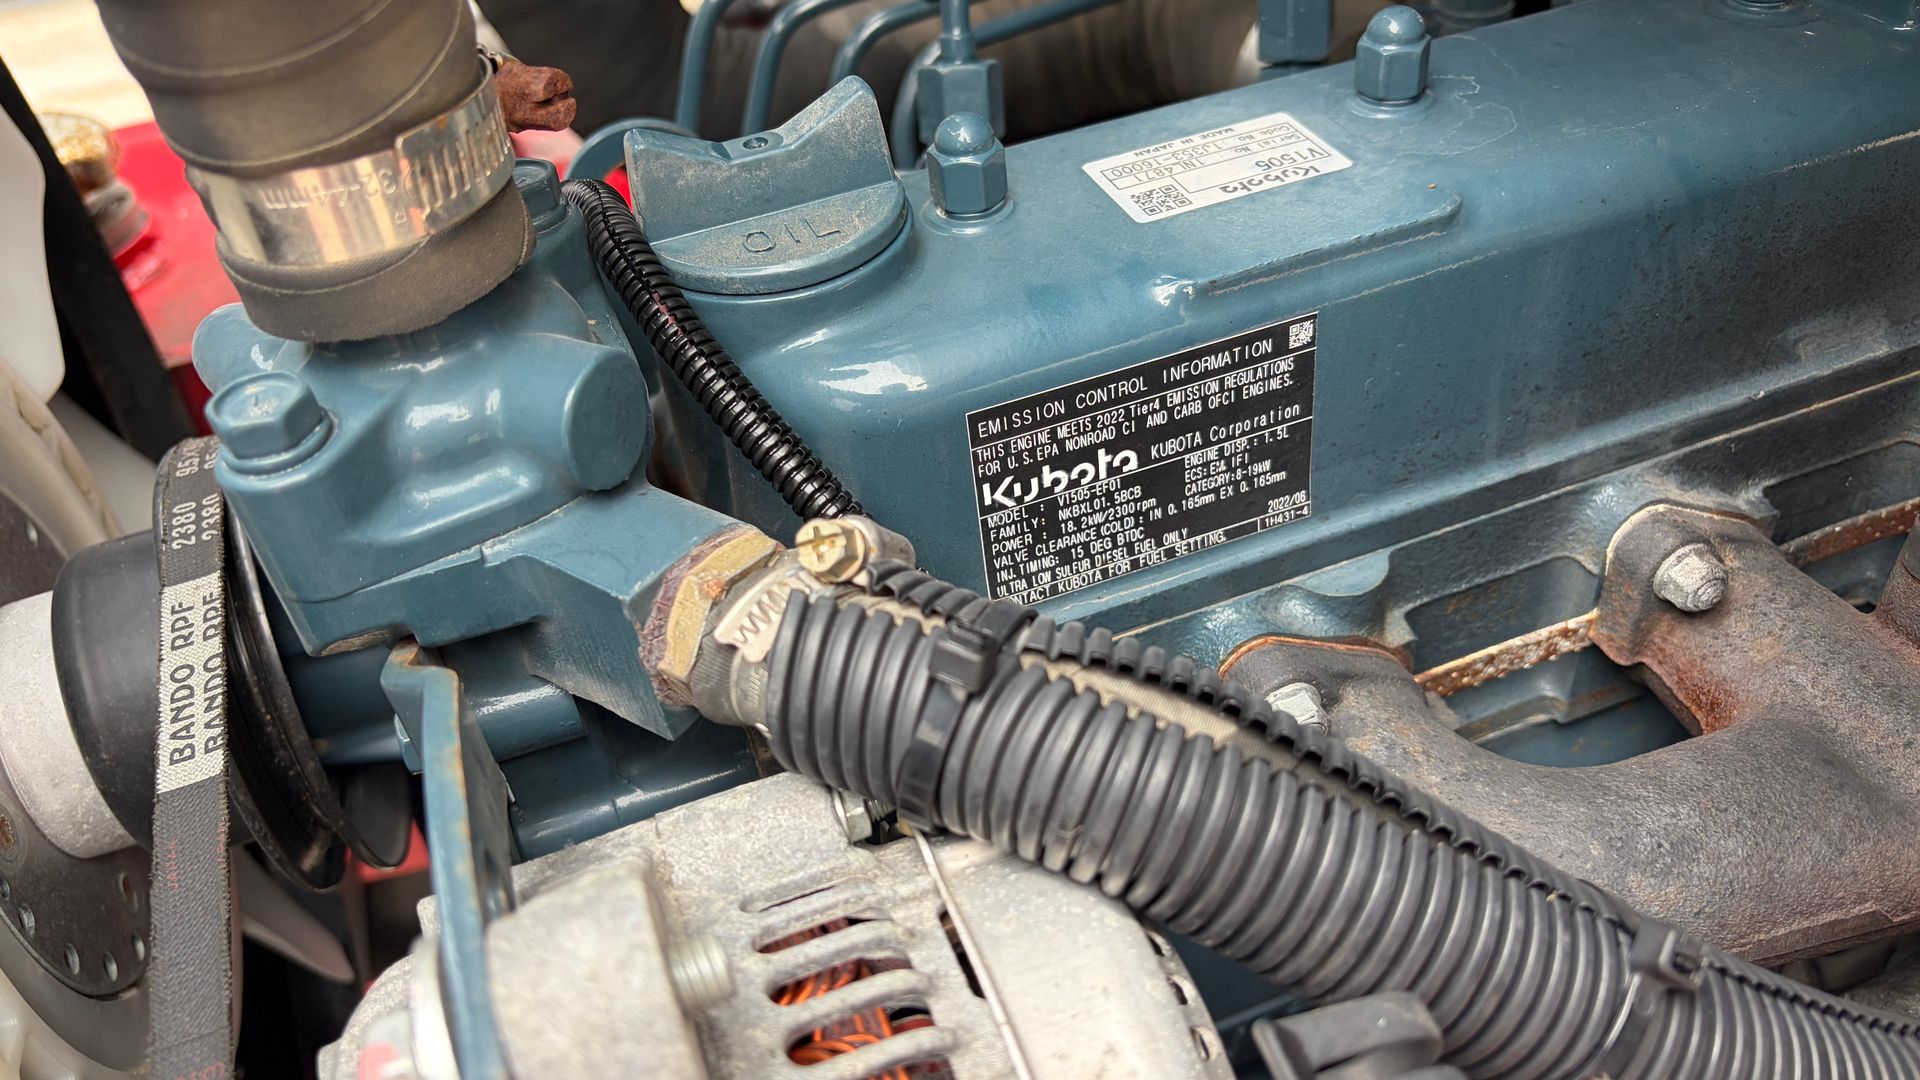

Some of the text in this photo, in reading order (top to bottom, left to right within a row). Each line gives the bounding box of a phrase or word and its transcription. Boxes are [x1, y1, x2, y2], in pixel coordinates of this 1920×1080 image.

[1133, 126, 1234, 157] MADE IN JAPAN
[1257, 132, 1302, 148] Serial
[1259, 124, 1290, 138] Code
[1110, 143, 1221, 178] 1J353-16000
[1132, 157, 1203, 182] 1NL4871
[1220, 165, 1320, 195] Kubota
[1254, 147, 1325, 172] V1505
[743, 217, 841, 253] OIL
[976, 357, 1295, 462] THIS ENGINE MEETS 2022 Tier4 EMISSION REGULATIONS
[978, 338, 1272, 439] EMISSION CONTROL INFORMATION
[978, 461, 1001, 478] FOR
[1065, 426, 1116, 452] NONROAD
[1122, 420, 1135, 435] CI
[1146, 411, 1168, 428] AND
[1173, 400, 1202, 420] CARB
[1208, 390, 1235, 409] OFCI
[1242, 374, 1294, 399] ENGINES.
[1184, 448, 1219, 469] ENGINE
[1264, 426, 1289, 444] 1.5L
[982, 404, 1300, 508] Kubota KUBOTA Corporation
[1231, 452, 1249, 468] IFI
[987, 508, 1029, 529] MODEL
[1057, 478, 1121, 507] V1505-EF01
[1267, 490, 1306, 513] 2022/06
[171, 500, 197, 551] 2380
[990, 517, 1045, 542] FAMILY:
[992, 535, 1033, 556] POWER
[1060, 497, 1157, 535] 18.2kW/2300rpm
[993, 552, 1028, 570] VALVE
[1035, 530, 1097, 556] CLEARANCE
[1149, 507, 1162, 522] IN
[1220, 485, 1234, 500] EX
[1070, 547, 1084, 560] 15
[1090, 537, 1112, 555] DEG
[1117, 526, 1145, 543] BTDC
[997, 528, 1189, 598] ULTRA LOW SULFUR DIESEL FUEL ONLY
[1009, 530, 1227, 606] NTACT KUBOTA FOR FUEL SETTING.
[170, 600, 195, 653] RPF
[170, 662, 196, 766] BANDO
